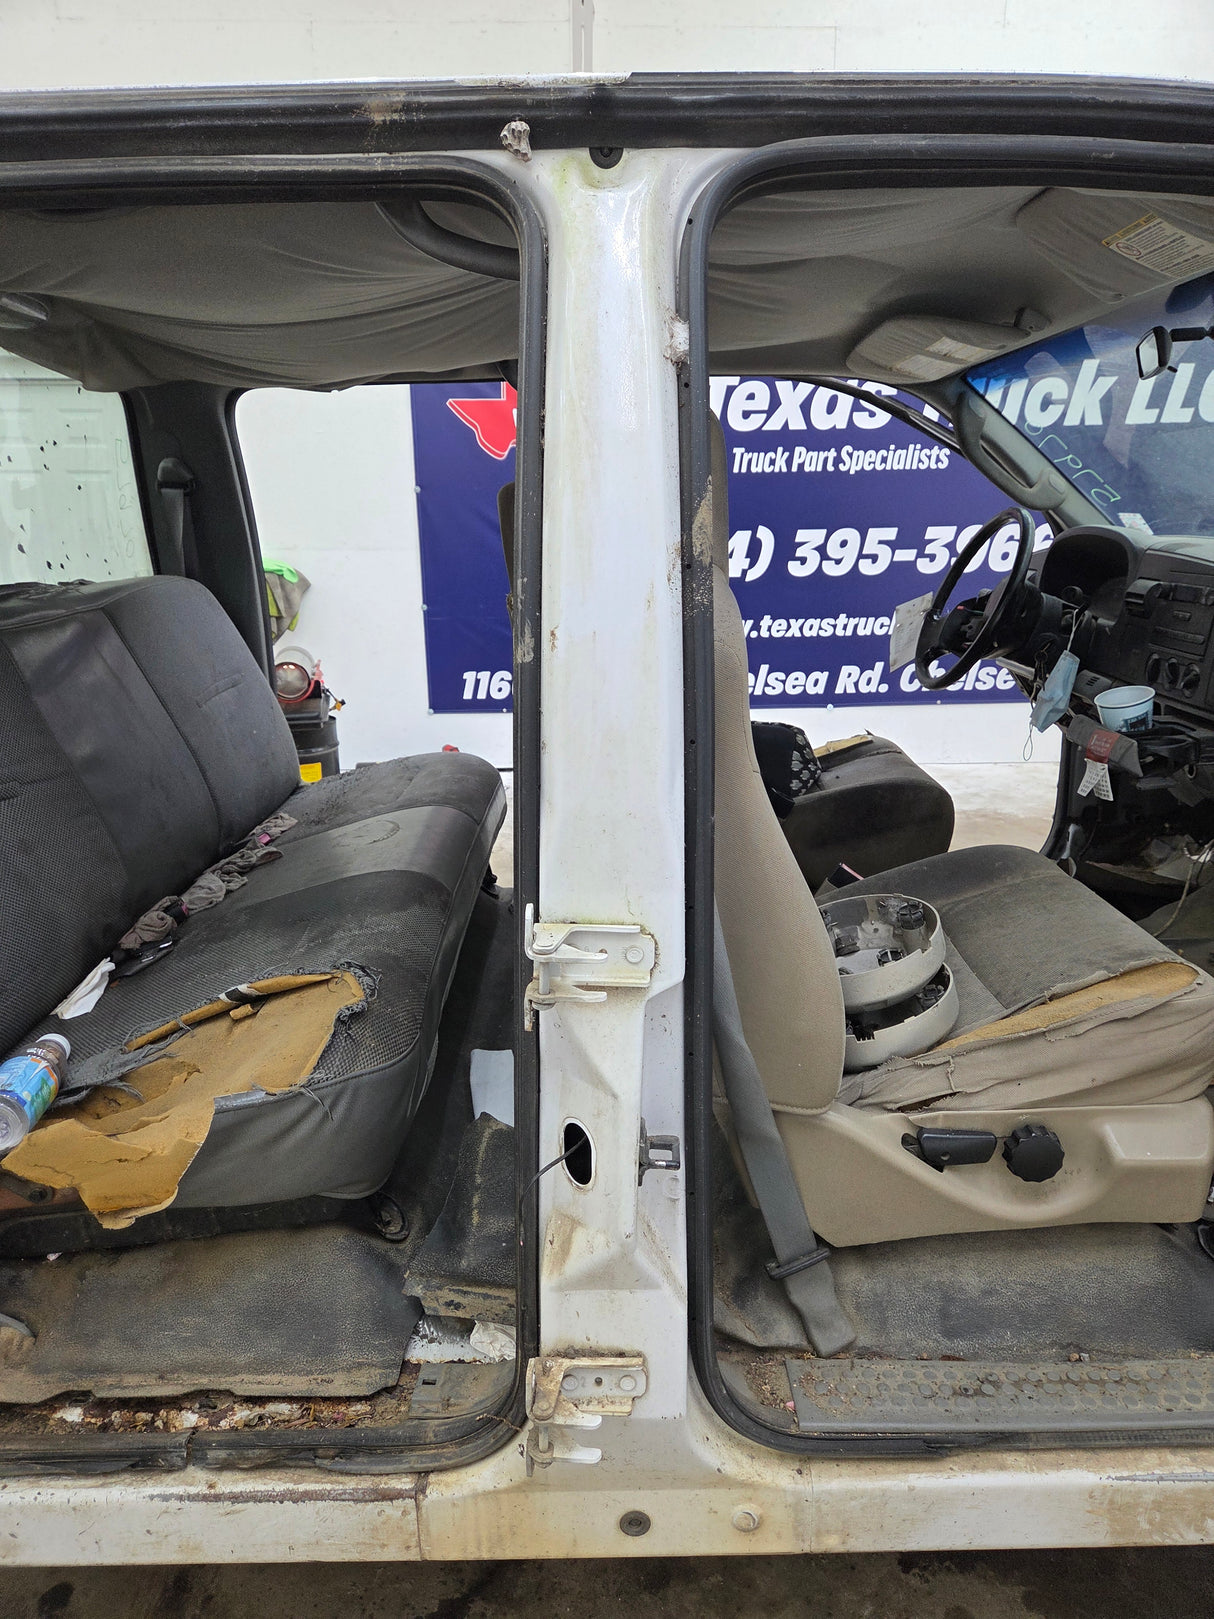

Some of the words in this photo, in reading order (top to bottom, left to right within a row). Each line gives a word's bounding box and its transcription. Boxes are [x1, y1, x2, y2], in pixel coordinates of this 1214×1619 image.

[733, 447, 788, 473] Truck
[791, 446, 836, 472] Part
[838, 444, 950, 474] Specialists
[835, 661, 889, 694] Rd.
